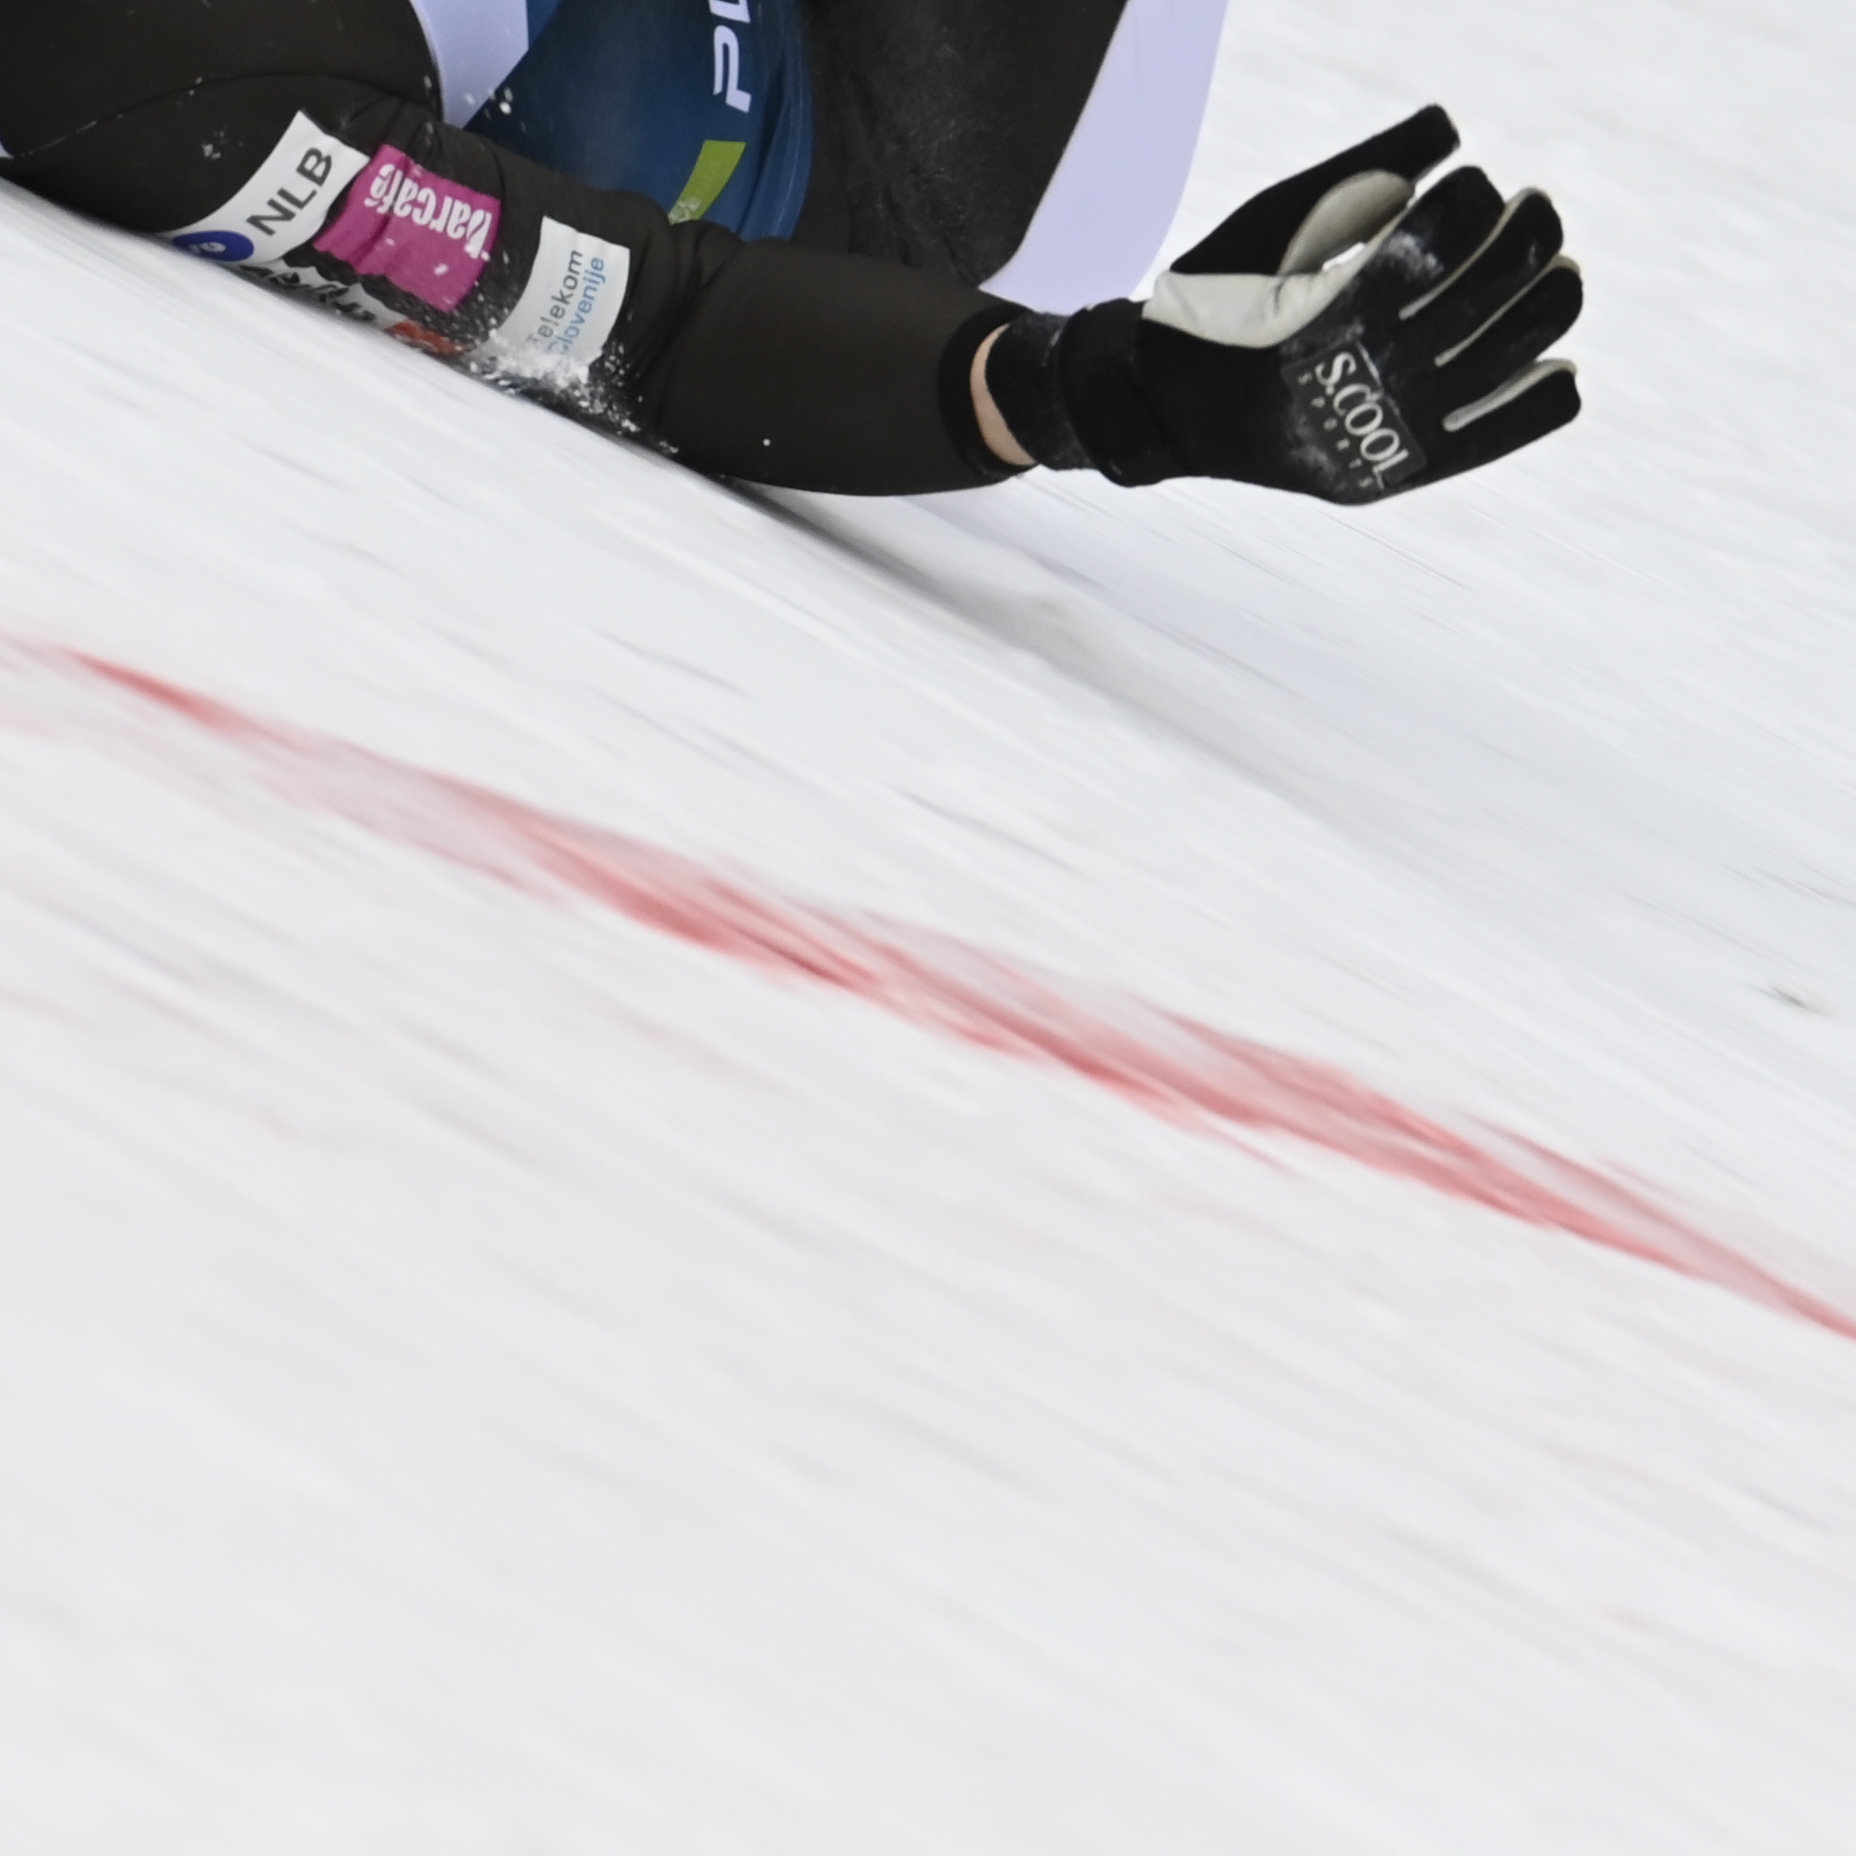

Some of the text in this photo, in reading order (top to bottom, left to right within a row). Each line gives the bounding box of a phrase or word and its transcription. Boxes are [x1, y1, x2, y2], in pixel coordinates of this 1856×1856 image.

[246, 147, 333, 236] NLB
[364, 163, 489, 259] barcafé
[1314, 351, 1409, 489] S.COOL
